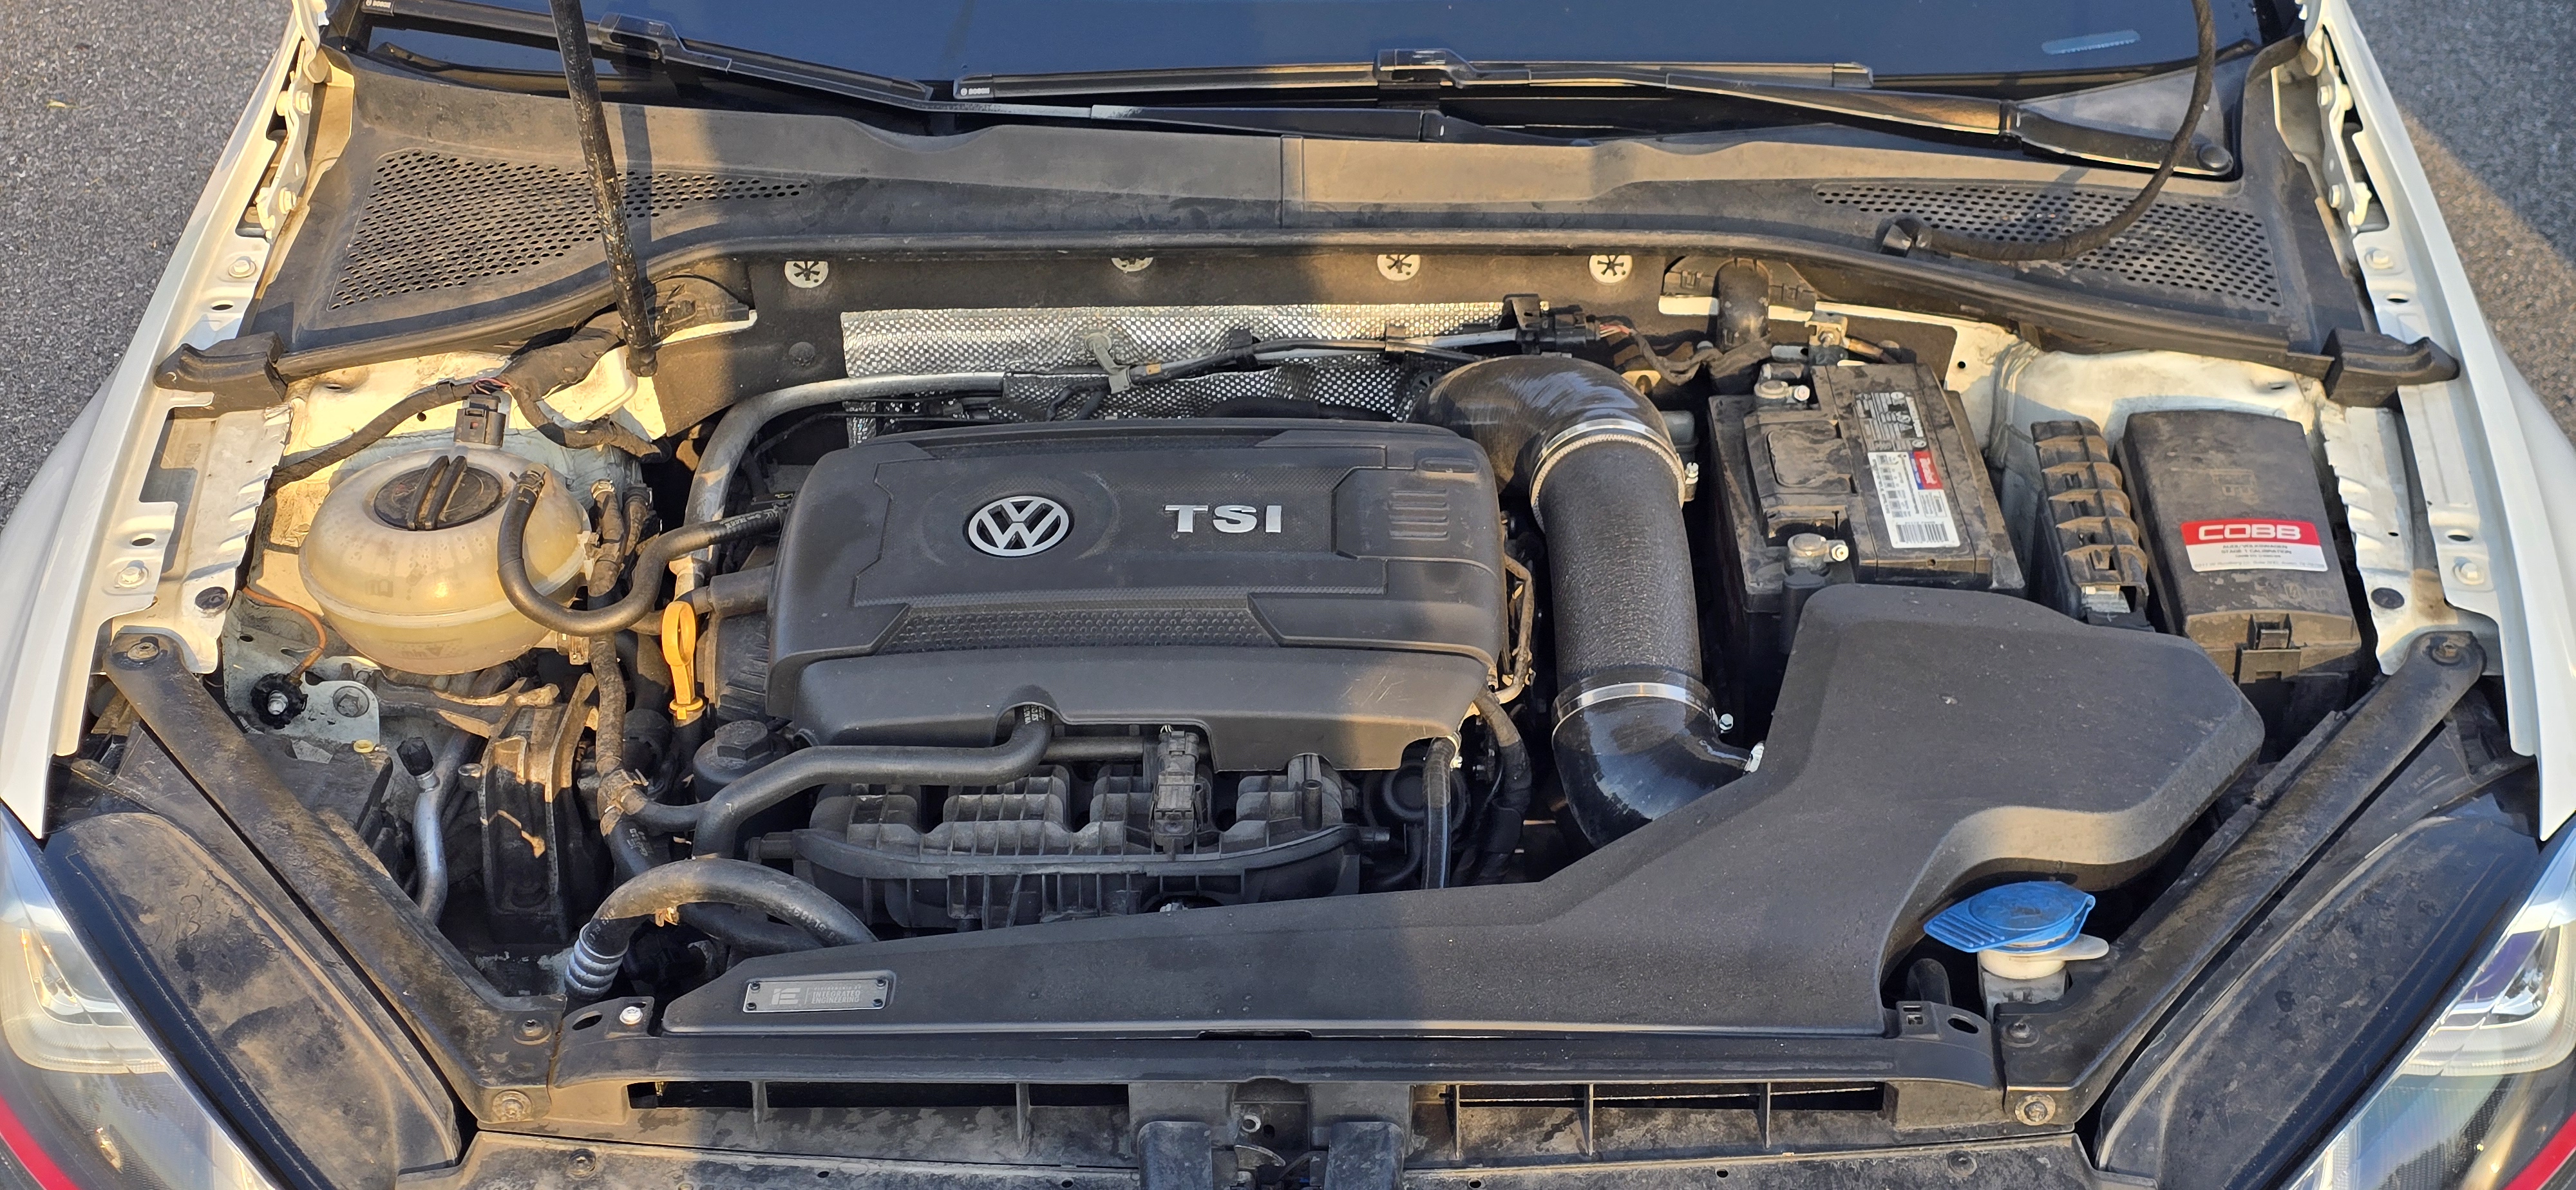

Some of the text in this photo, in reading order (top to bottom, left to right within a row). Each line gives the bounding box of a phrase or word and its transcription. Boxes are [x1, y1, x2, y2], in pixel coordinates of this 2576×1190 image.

[1165, 504, 1282, 533] TSI
[2198, 524, 2301, 540] COBB
[811, 996, 860, 1005] ENGINEERING
